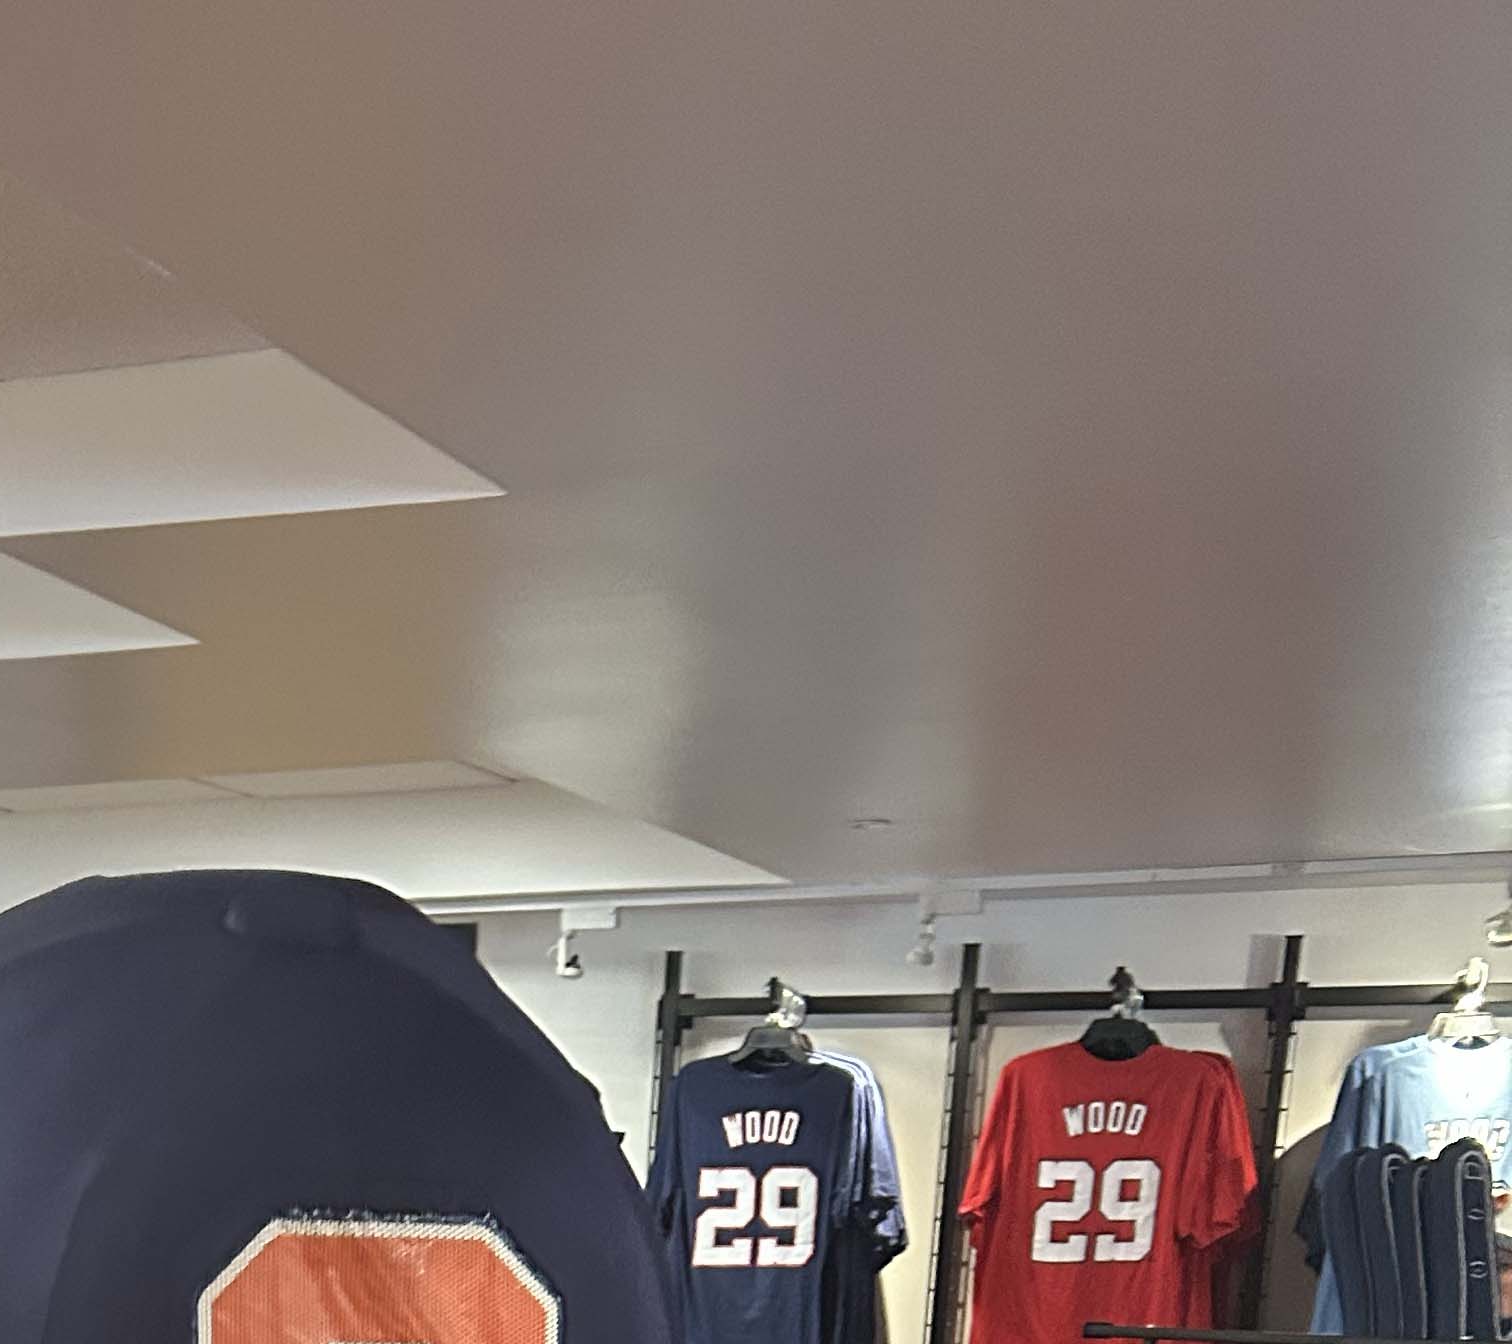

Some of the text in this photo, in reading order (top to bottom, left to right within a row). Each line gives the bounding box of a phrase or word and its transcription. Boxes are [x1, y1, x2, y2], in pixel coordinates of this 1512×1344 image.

[722, 1110, 800, 1148] WOOD
[1062, 1101, 1147, 1136] WOOD
[691, 1166, 818, 1267] 29
[1031, 1159, 1161, 1262] 29
